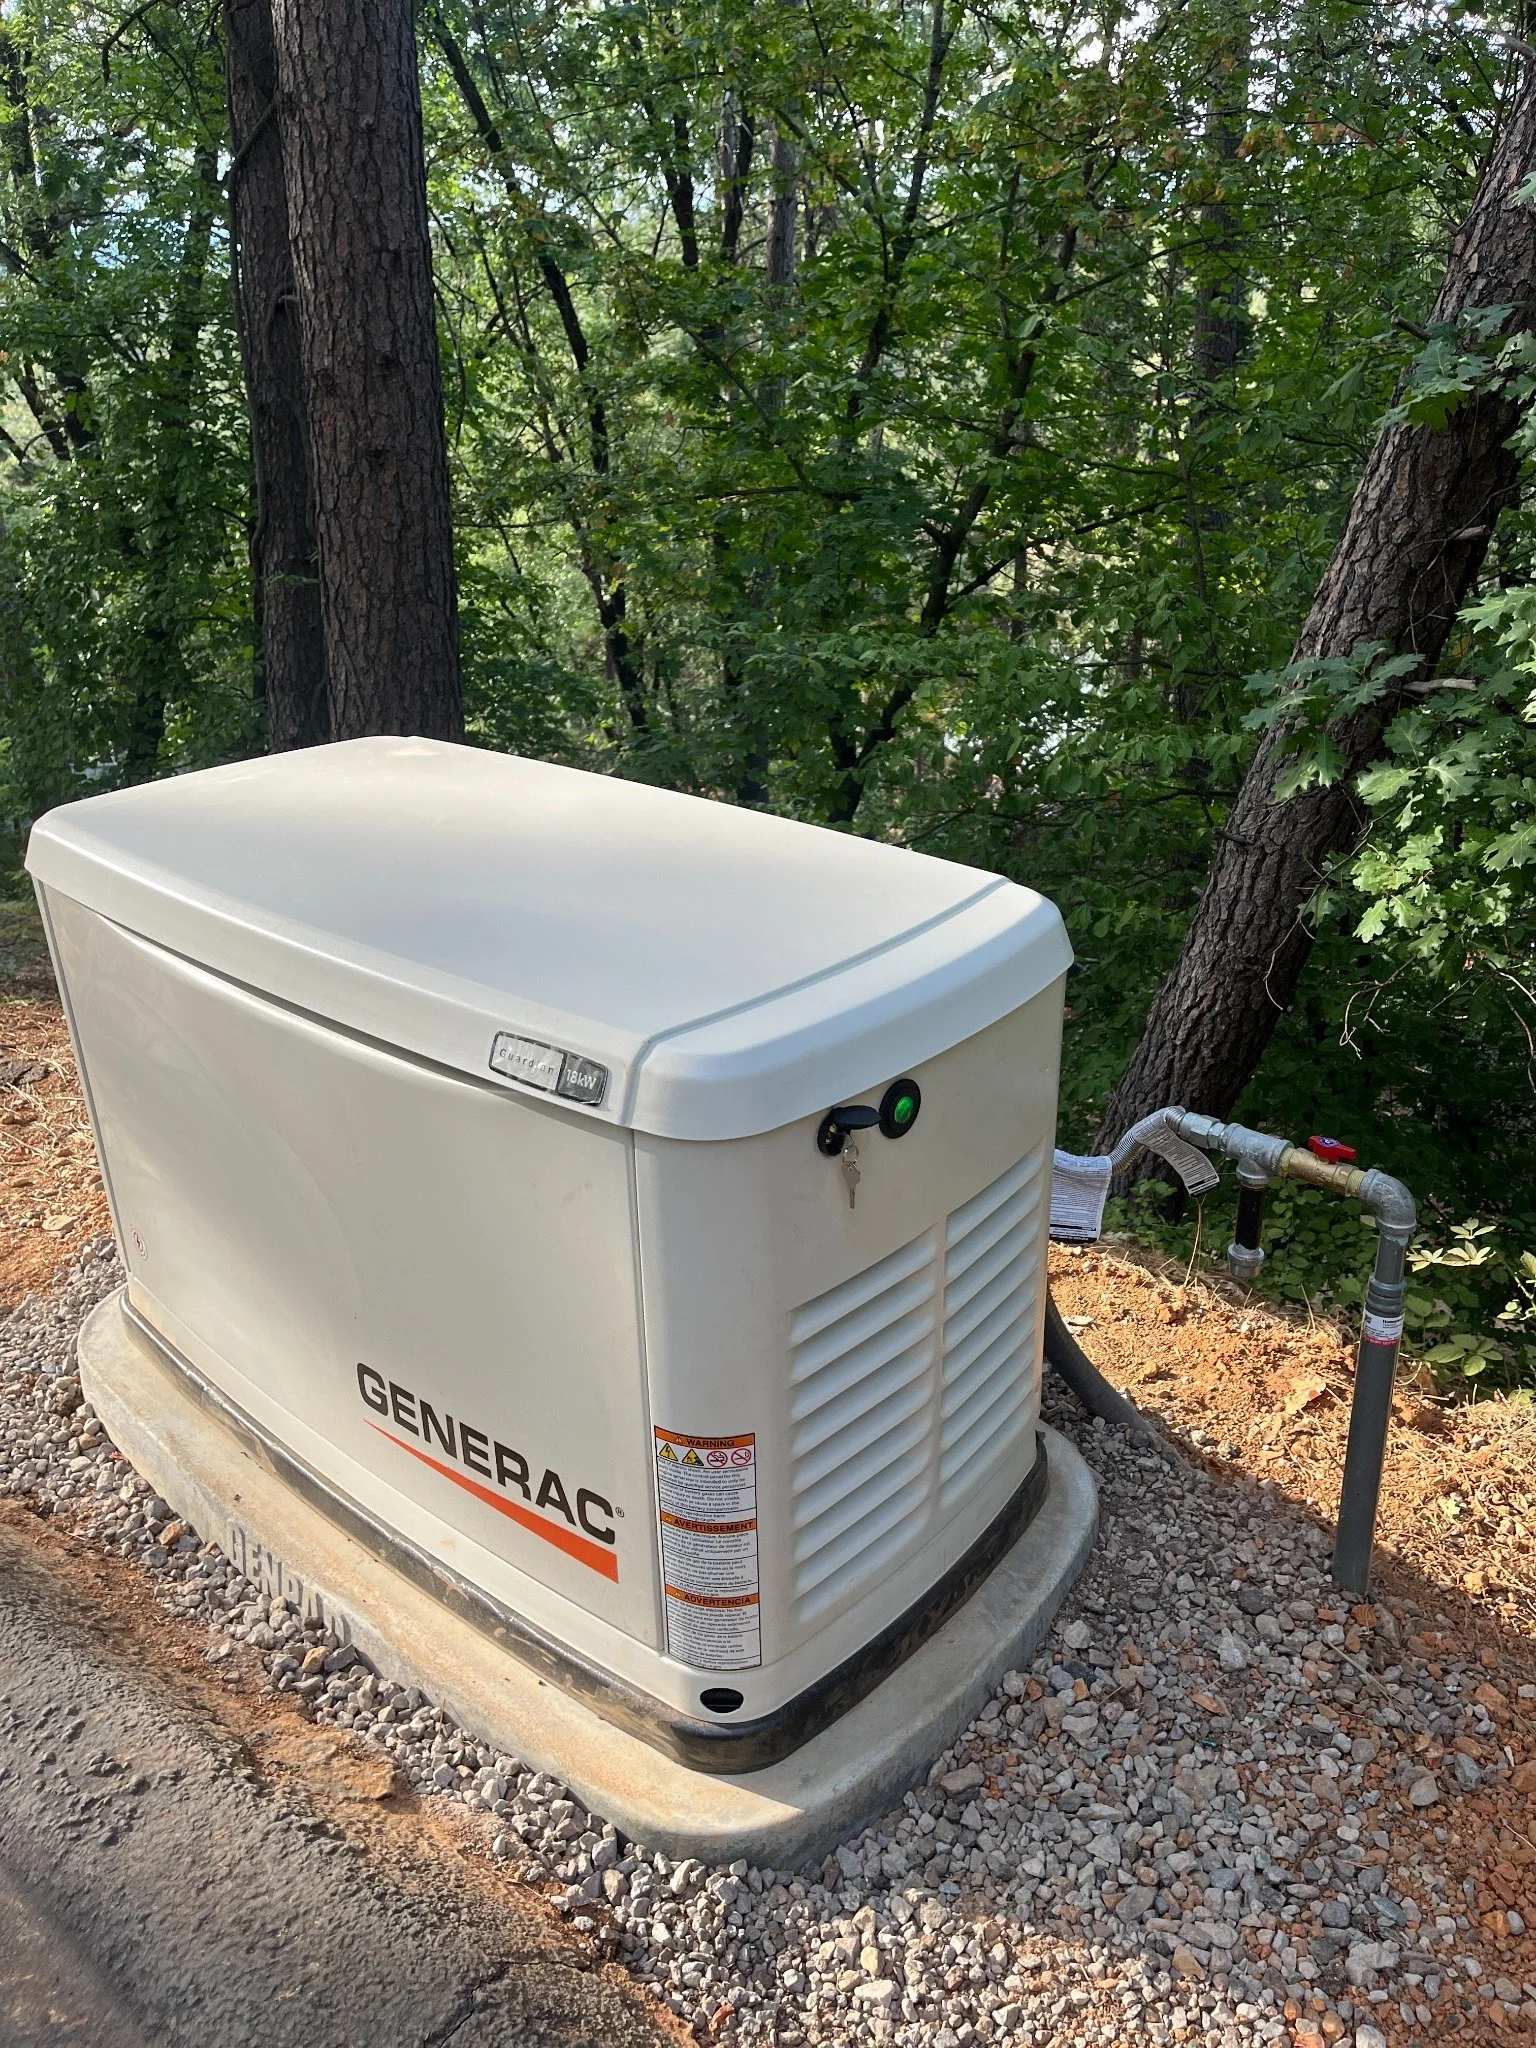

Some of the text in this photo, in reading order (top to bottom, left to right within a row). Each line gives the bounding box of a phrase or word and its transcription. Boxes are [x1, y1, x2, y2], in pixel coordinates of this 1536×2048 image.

[566, 1068, 598, 1090] 18kW
[686, 1437, 735, 1448] WARNING
[357, 1363, 616, 1545] GENERAC
[674, 1519, 753, 1532] AVERTISSEMENT
[684, 1593, 751, 1606] ADVERTENCIA
